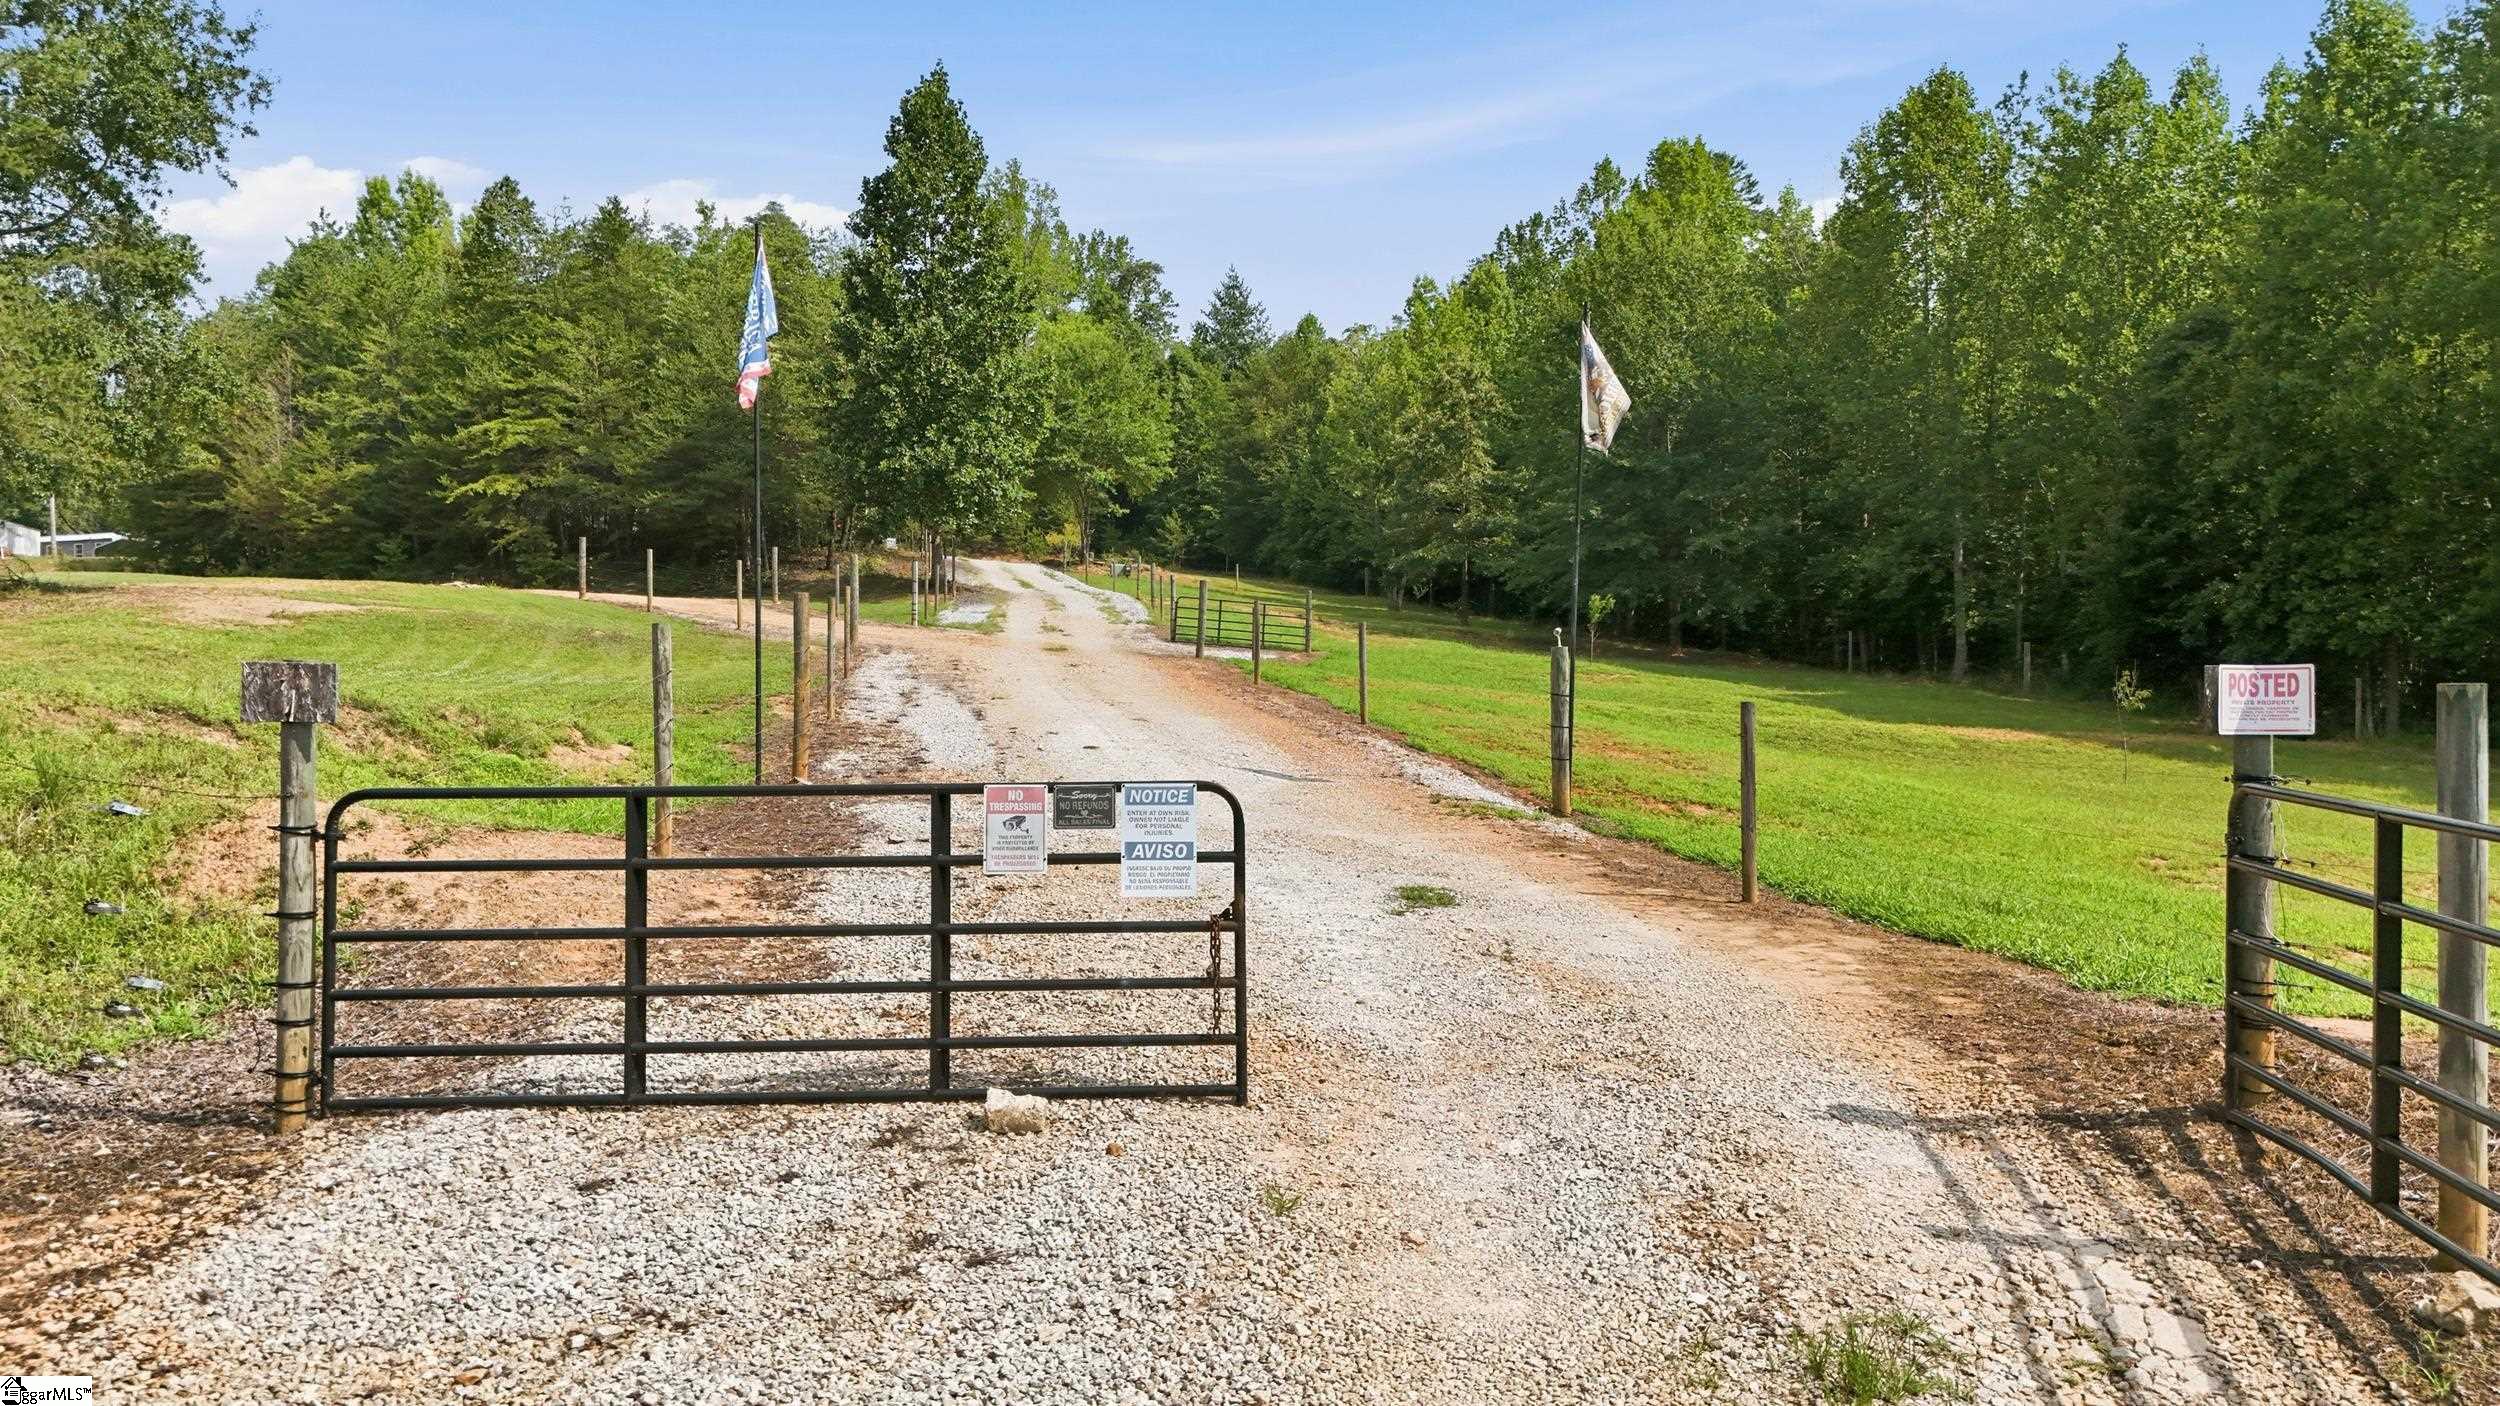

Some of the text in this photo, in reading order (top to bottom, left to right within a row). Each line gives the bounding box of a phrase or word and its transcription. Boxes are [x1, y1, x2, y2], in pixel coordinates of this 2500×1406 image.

[2228, 672, 2300, 698] POSTED
[1008, 790, 1024, 801] NO
[1129, 789, 1189, 803] NOTICE
[989, 802, 1042, 811] TRESPASSING
[1059, 801, 1110, 810] NO REFUNDS
[1131, 843, 1188, 859] AVISO
